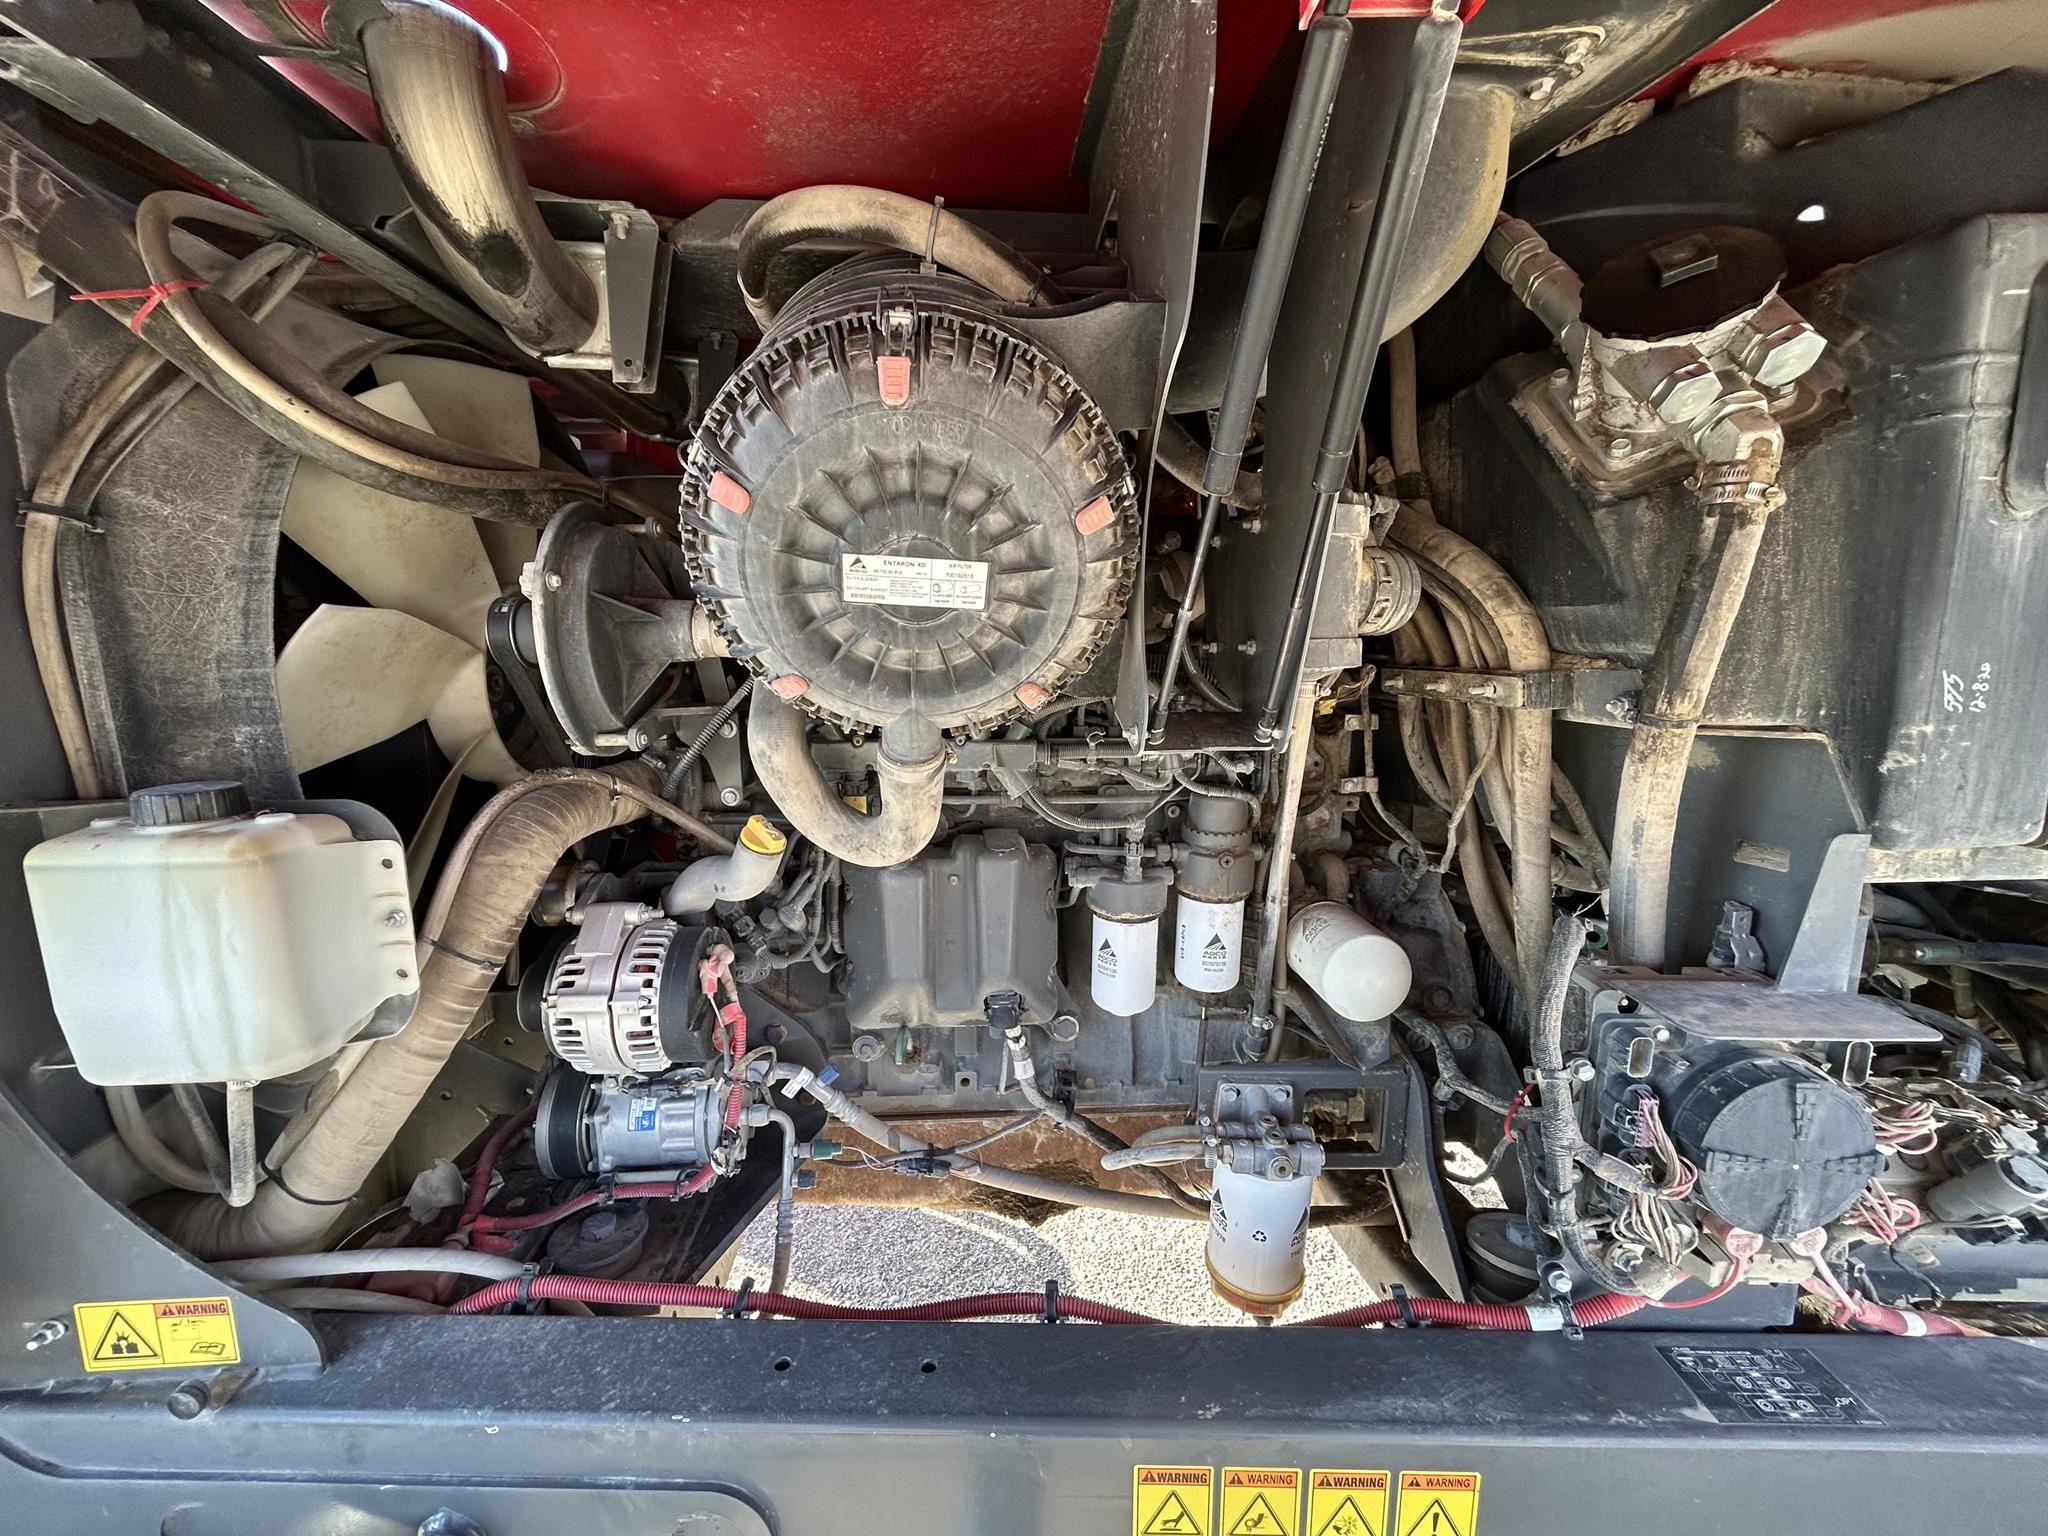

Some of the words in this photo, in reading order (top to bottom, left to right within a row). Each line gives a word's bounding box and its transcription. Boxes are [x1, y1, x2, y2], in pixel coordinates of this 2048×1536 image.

[883, 559, 915, 568] ENTARON
[175, 1303, 227, 1315] WARNING
[1157, 1472, 1208, 1484] WARNING
[1247, 1474, 1293, 1485] WARNING
[1333, 1476, 1384, 1488] WARNING
[1426, 1478, 1471, 1489] WARNING
